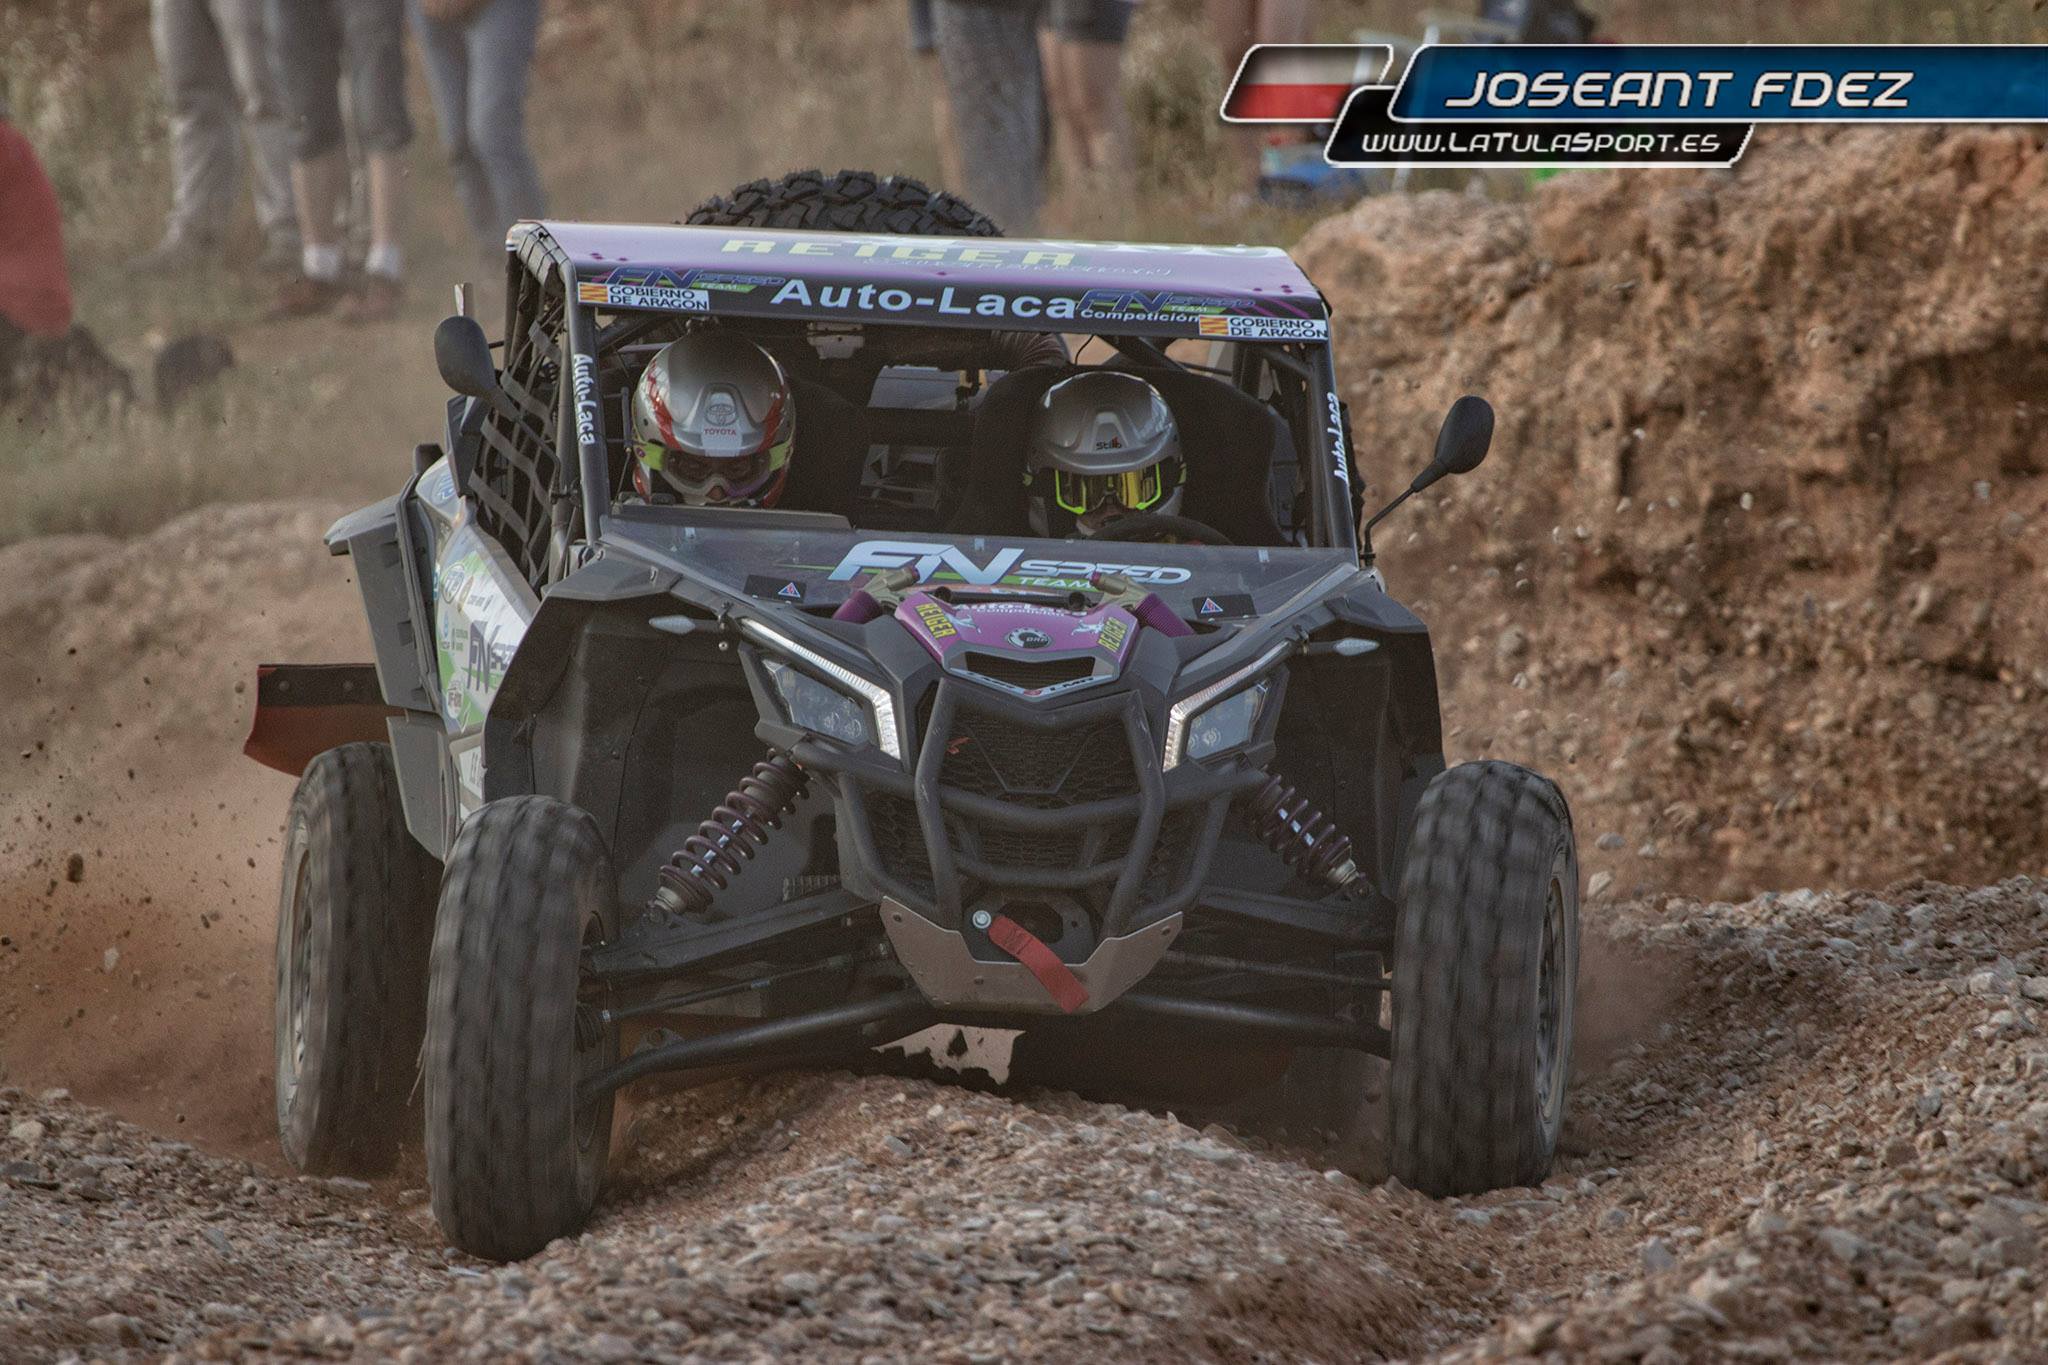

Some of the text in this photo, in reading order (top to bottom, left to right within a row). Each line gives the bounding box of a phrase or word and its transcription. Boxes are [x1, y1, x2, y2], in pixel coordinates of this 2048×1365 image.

[721, 239, 1077, 267] REIGER
[609, 285, 695, 300] GOBIERNO
[770, 278, 1076, 320] Auto-Laca
[610, 295, 709, 311] DE ARAGON
[1229, 317, 1315, 330] GOBIERNO
[1230, 327, 1329, 339] DE ARAGON
[703, 428, 737, 436] TOYOTA
[828, 540, 1025, 585] FN
[1018, 577, 1092, 589] TEAM
[915, 603, 957, 639] REIGER
